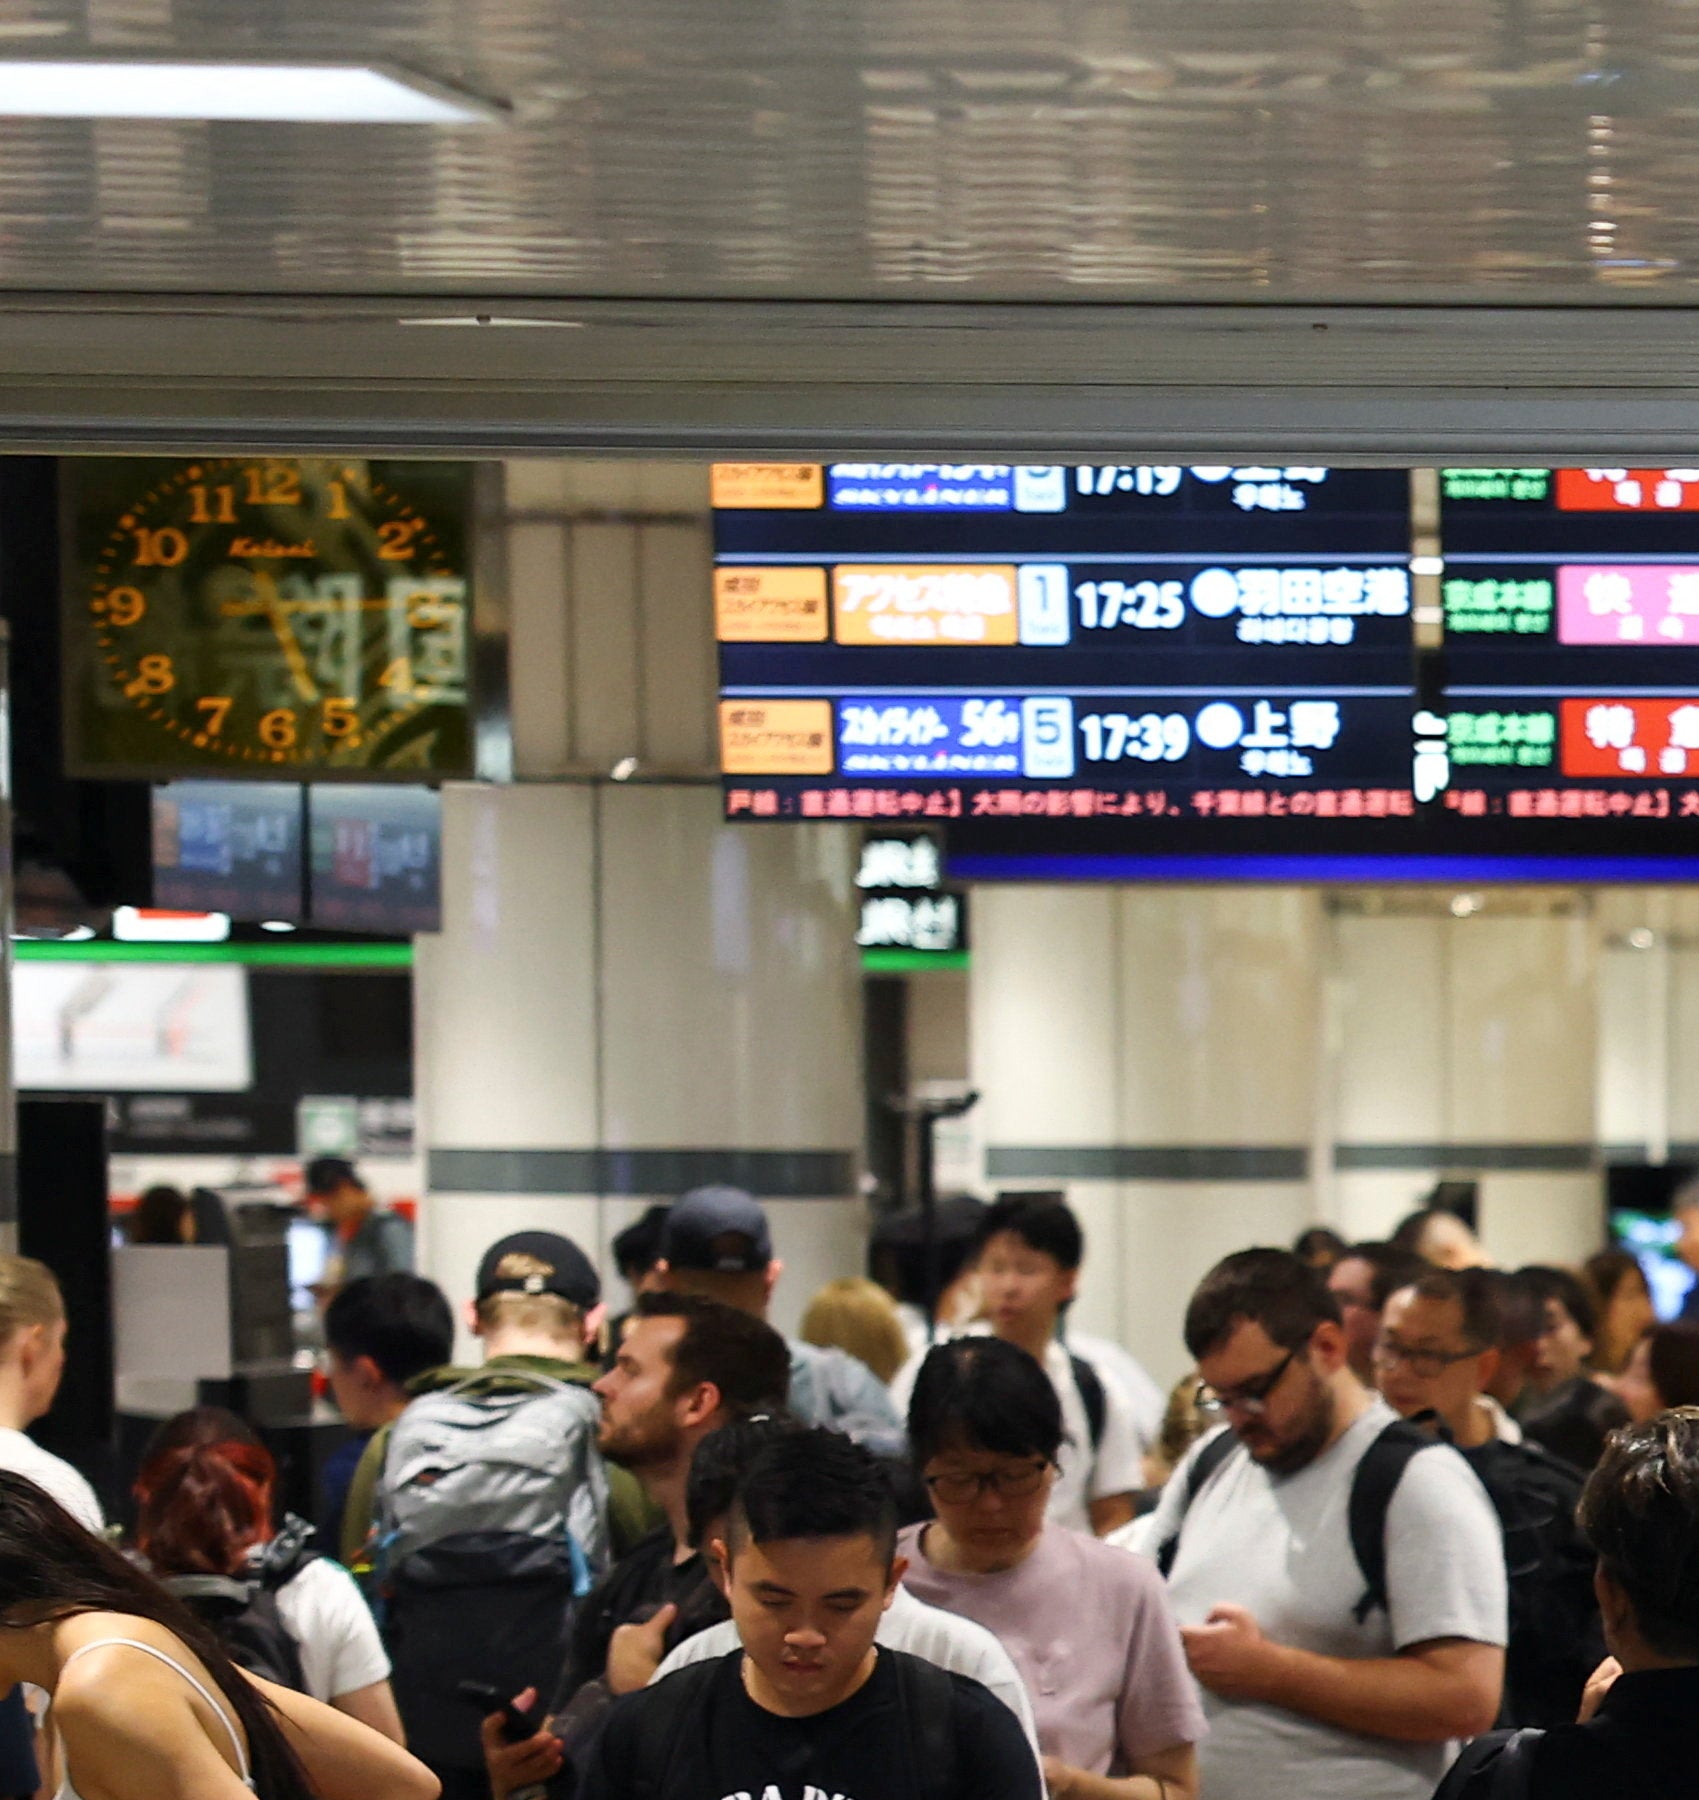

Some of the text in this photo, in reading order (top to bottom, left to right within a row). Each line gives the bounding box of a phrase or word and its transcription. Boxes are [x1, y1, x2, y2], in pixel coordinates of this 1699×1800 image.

[188, 485, 239, 523] 11
[244, 467, 300, 505] 12
[326, 482, 351, 519] 1
[132, 527, 188, 567] 10
[377, 522, 418, 560] 2
[107, 586, 146, 627] 9
[1033, 574, 1048, 612] 1
[1075, 580, 1184, 629] 17:25
[138, 654, 176, 695] 8
[196, 697, 232, 735] 7
[259, 709, 296, 748] 6
[323, 697, 359, 737] 5
[1035, 707, 1060, 745] 5
[1240, 700, 1340, 750] 上野
[1079, 714, 1189, 762] 17:39
